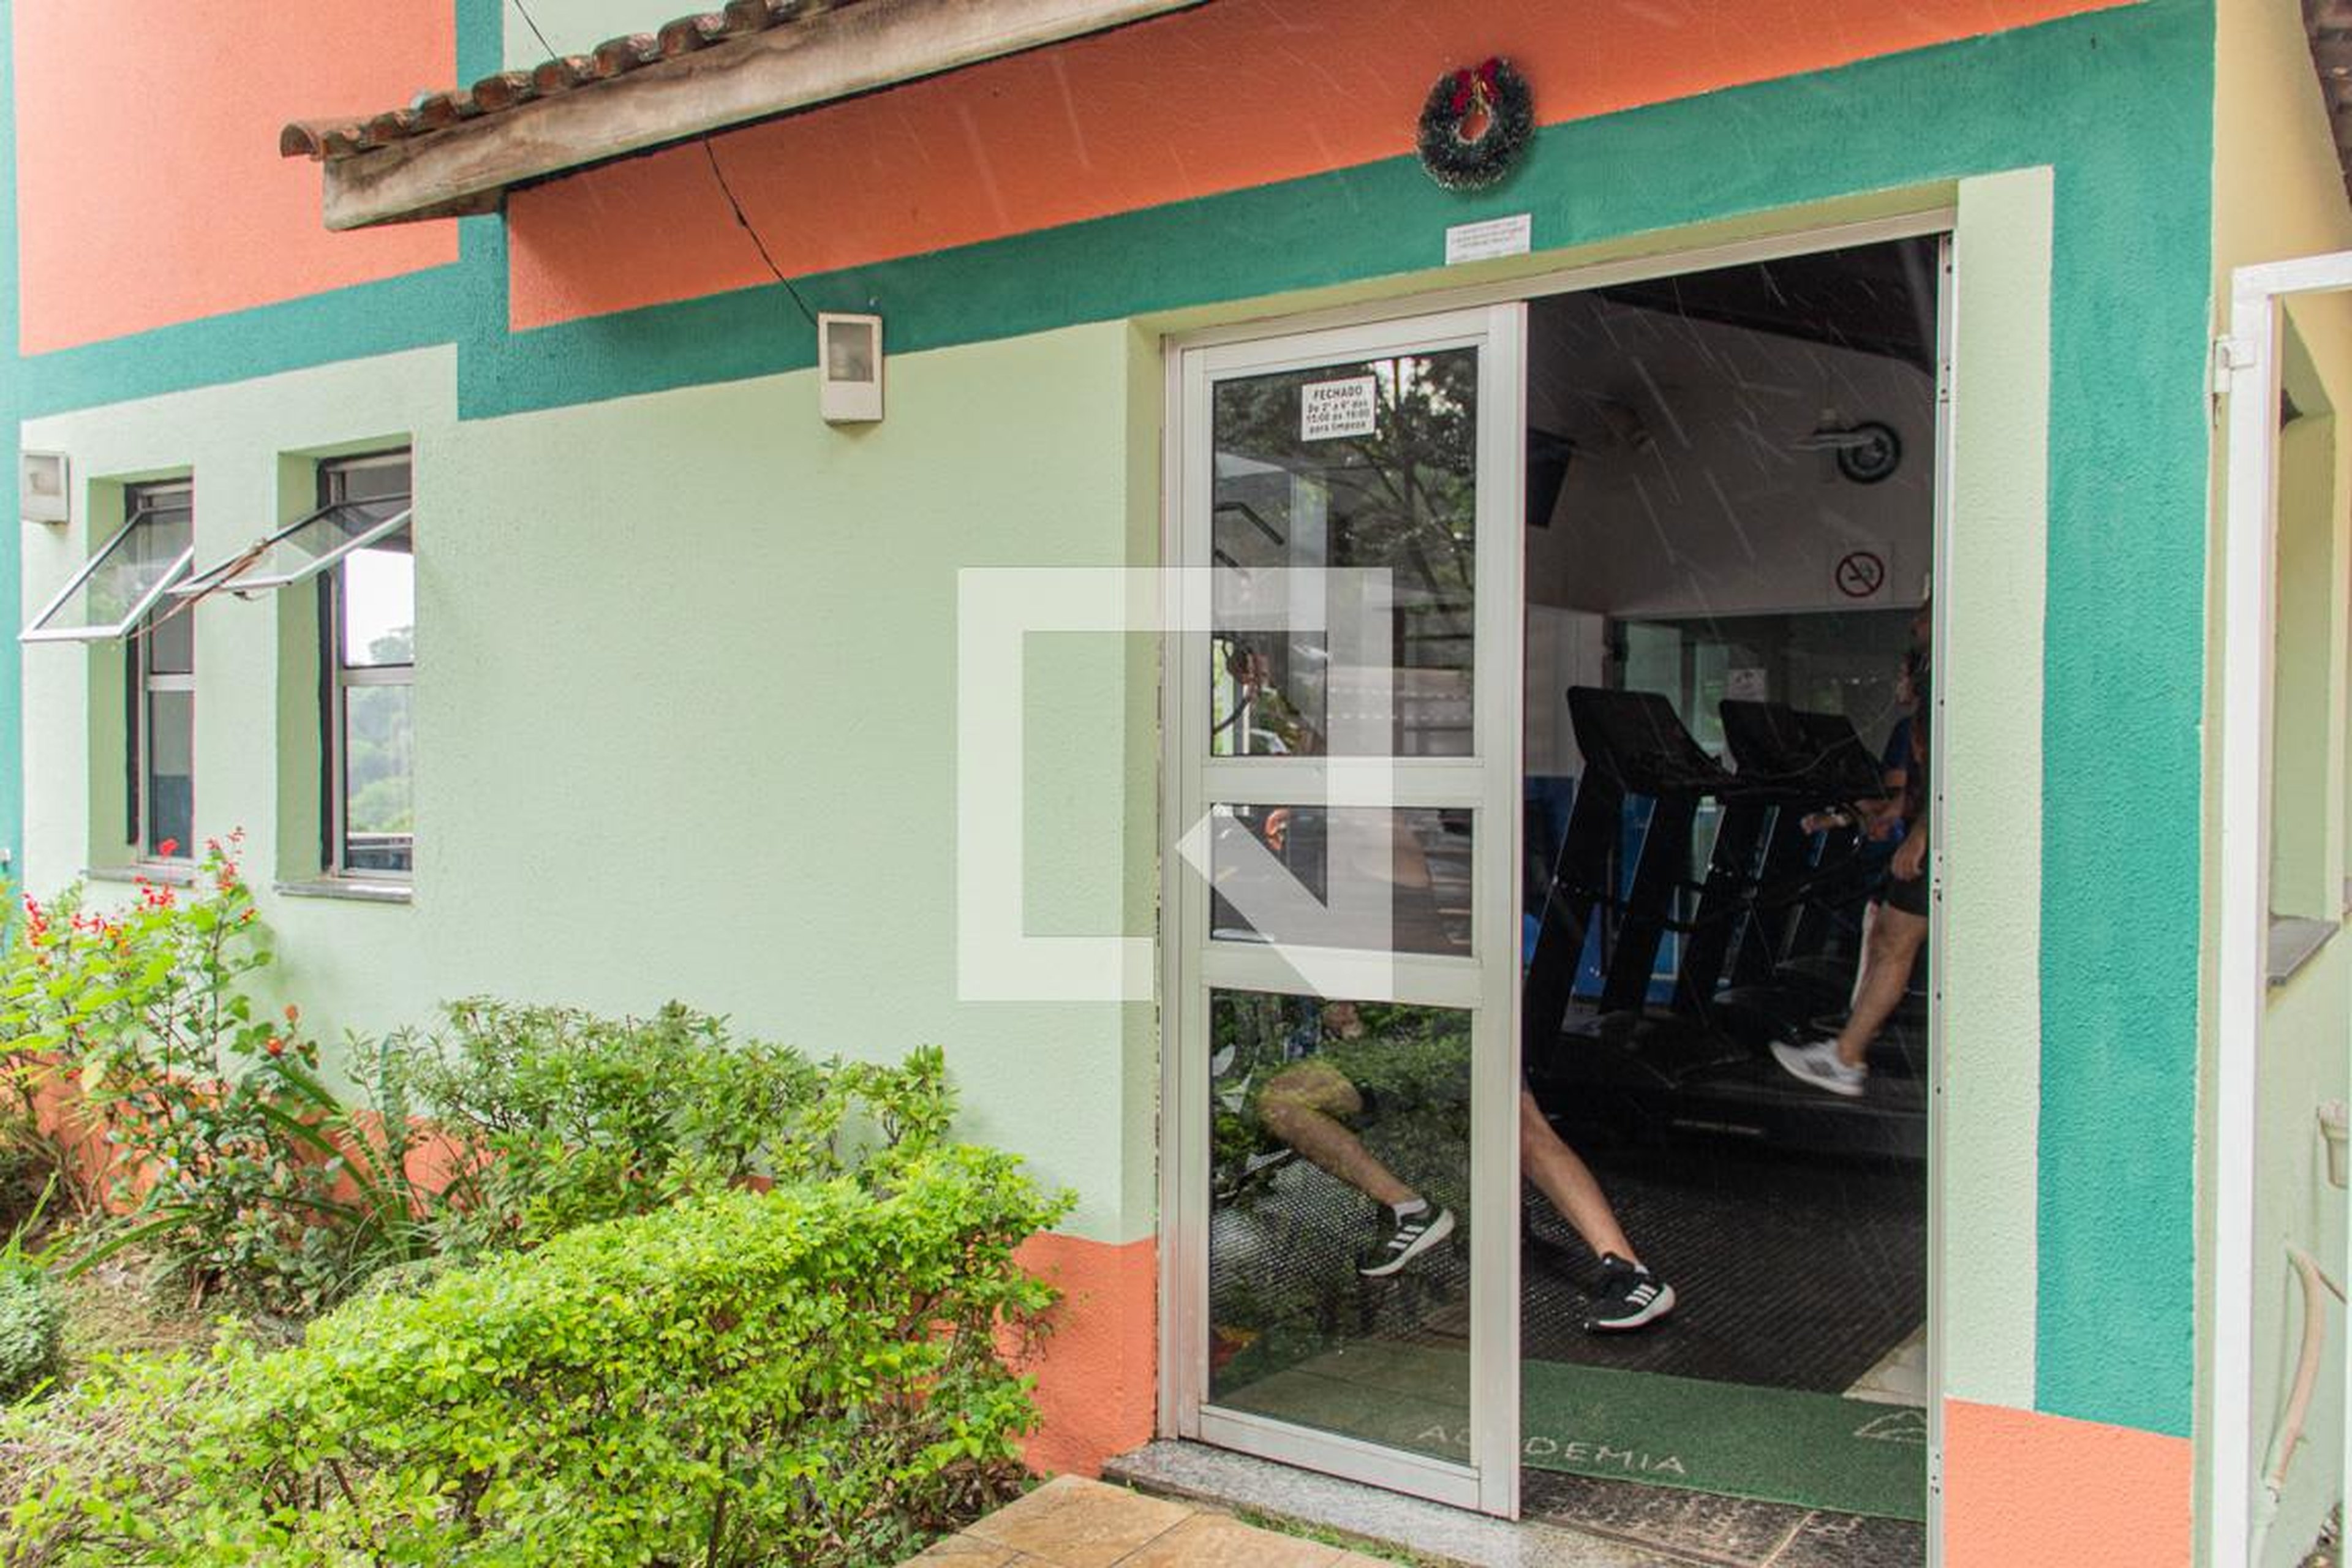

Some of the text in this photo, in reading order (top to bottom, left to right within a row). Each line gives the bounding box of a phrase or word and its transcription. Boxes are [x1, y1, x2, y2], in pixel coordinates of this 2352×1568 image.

[1314, 385, 1363, 401] FECHADO
[1310, 421, 1366, 434] para limpeza
[1417, 1424, 1686, 1474] ACDEMIA
